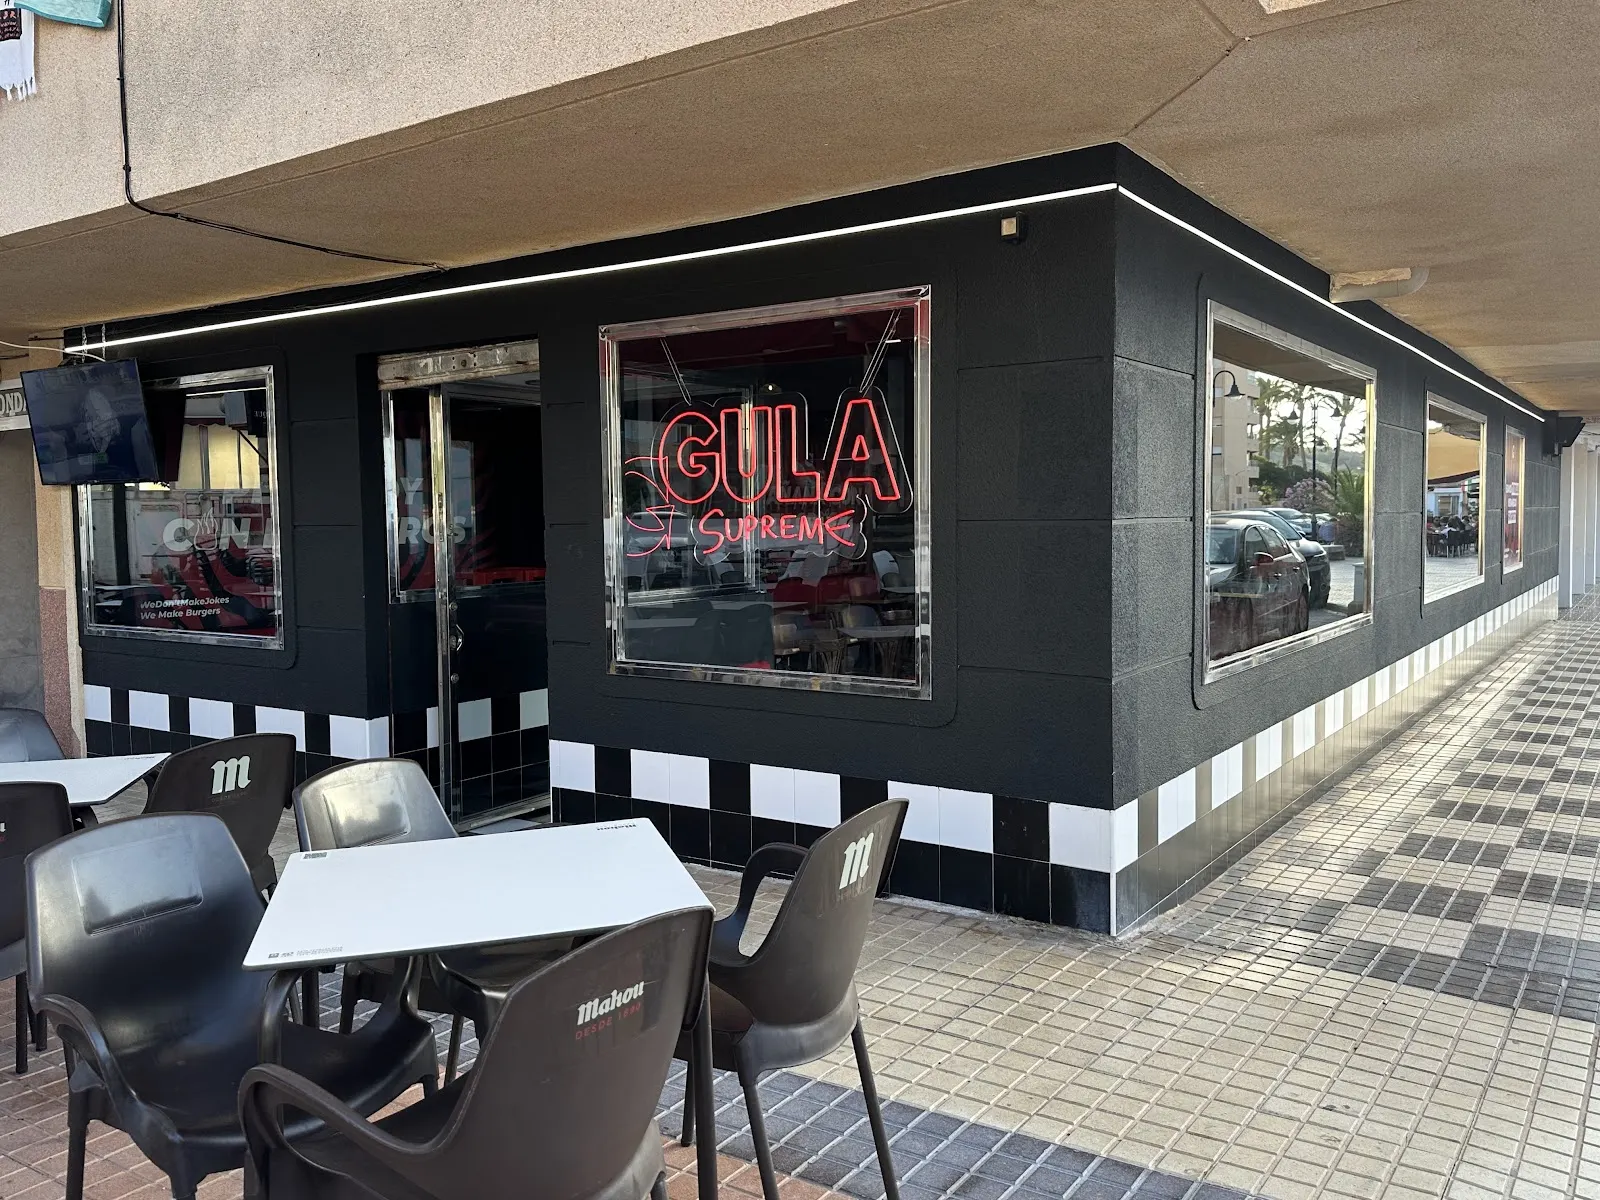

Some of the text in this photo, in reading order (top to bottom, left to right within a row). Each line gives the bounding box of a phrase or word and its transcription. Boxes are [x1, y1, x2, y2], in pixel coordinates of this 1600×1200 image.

[659, 399, 900, 504] GULA
[699, 508, 855, 554] SUPREME
[140, 608, 221, 620] We Make Burgers
[575, 1016, 613, 1040] DESDE
